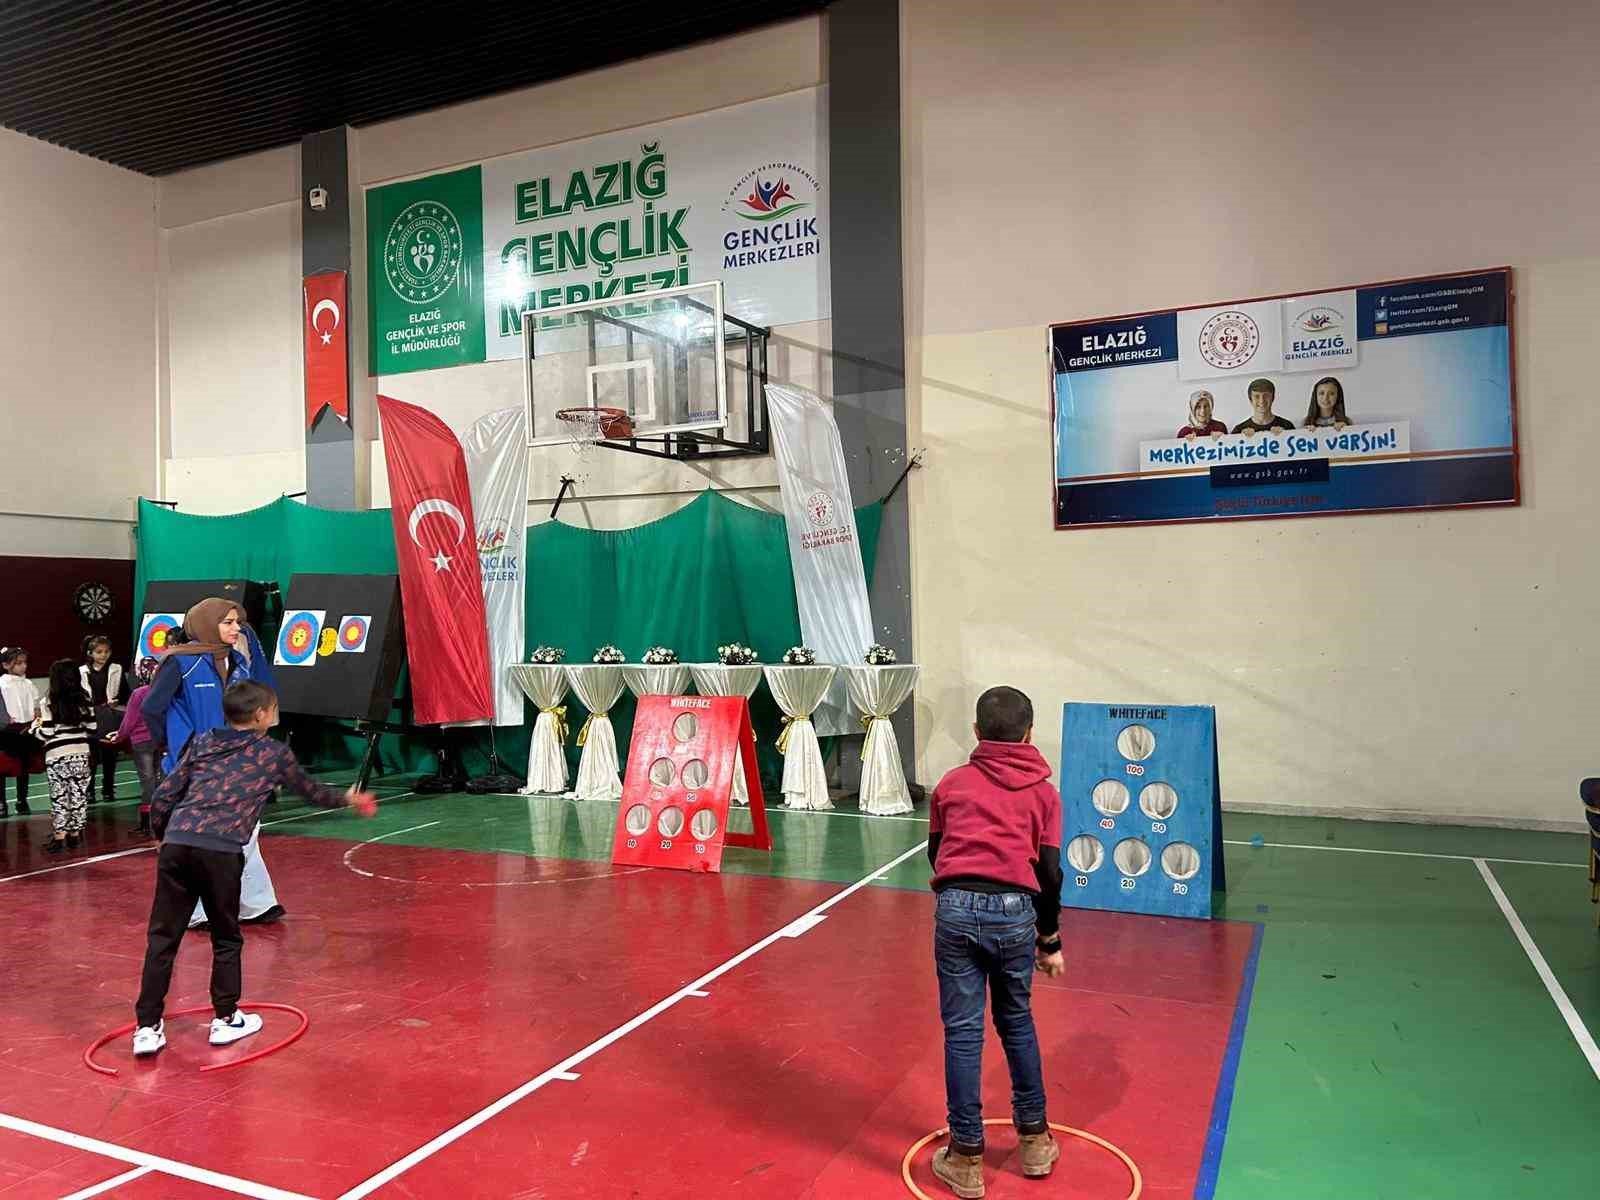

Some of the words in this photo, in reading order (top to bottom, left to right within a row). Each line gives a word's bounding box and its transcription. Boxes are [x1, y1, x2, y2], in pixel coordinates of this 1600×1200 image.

[515, 142, 667, 223] ELAZIĞ
[501, 200, 690, 276] GENÇLİK
[723, 217, 817, 250] GENÇLİK
[723, 237, 820, 269] MERKEZLERİ
[409, 308, 441, 324] ELAZIĞ
[386, 325, 424, 341] GENÇLİK
[427, 325, 439, 336] VE
[441, 320, 466, 332] SPOR
[1082, 325, 1147, 352] ELAZIĞ
[391, 342, 399, 355] İL
[401, 334, 461, 353] MÜDÜRLÜĞÜ
[1293, 334, 1344, 352] ELAZIĞ
[1069, 353, 1113, 367] GENÇLİK
[1115, 346, 1162, 362] MERKEZİ
[1285, 351, 1318, 360] GENÇLİK
[1321, 348, 1353, 357] MERKEZİ
[1109, 708, 1168, 720] WHITEFACE
[1127, 765, 1143, 775] 100
[1101, 819, 1113, 828] 40
[1153, 824, 1165, 833] 50
[1077, 877, 1087, 886] 10
[1122, 879, 1134, 888] 20
[1174, 884, 1186, 894] 30
